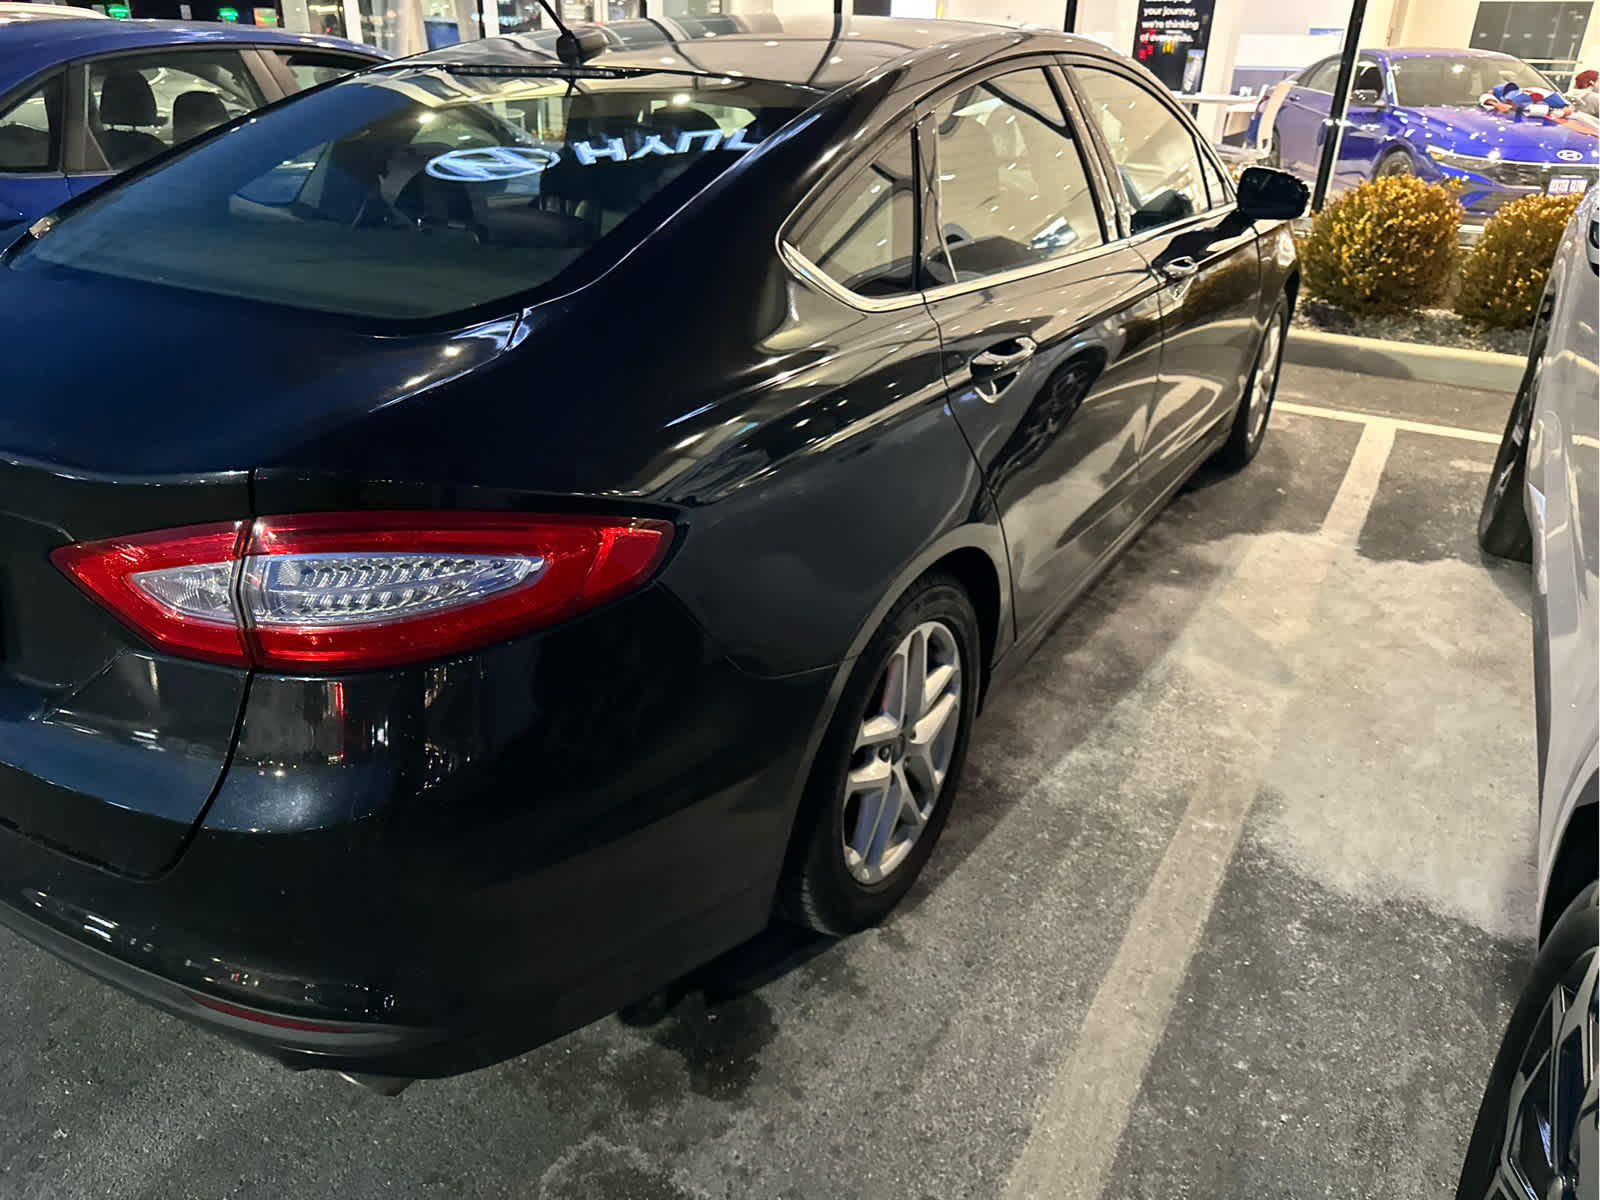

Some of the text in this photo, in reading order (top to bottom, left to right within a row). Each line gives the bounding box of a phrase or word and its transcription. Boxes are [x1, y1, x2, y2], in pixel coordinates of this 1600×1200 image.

[1143, 8, 1162, 17] your
[1141, 19, 1200, 31] we're thinking
